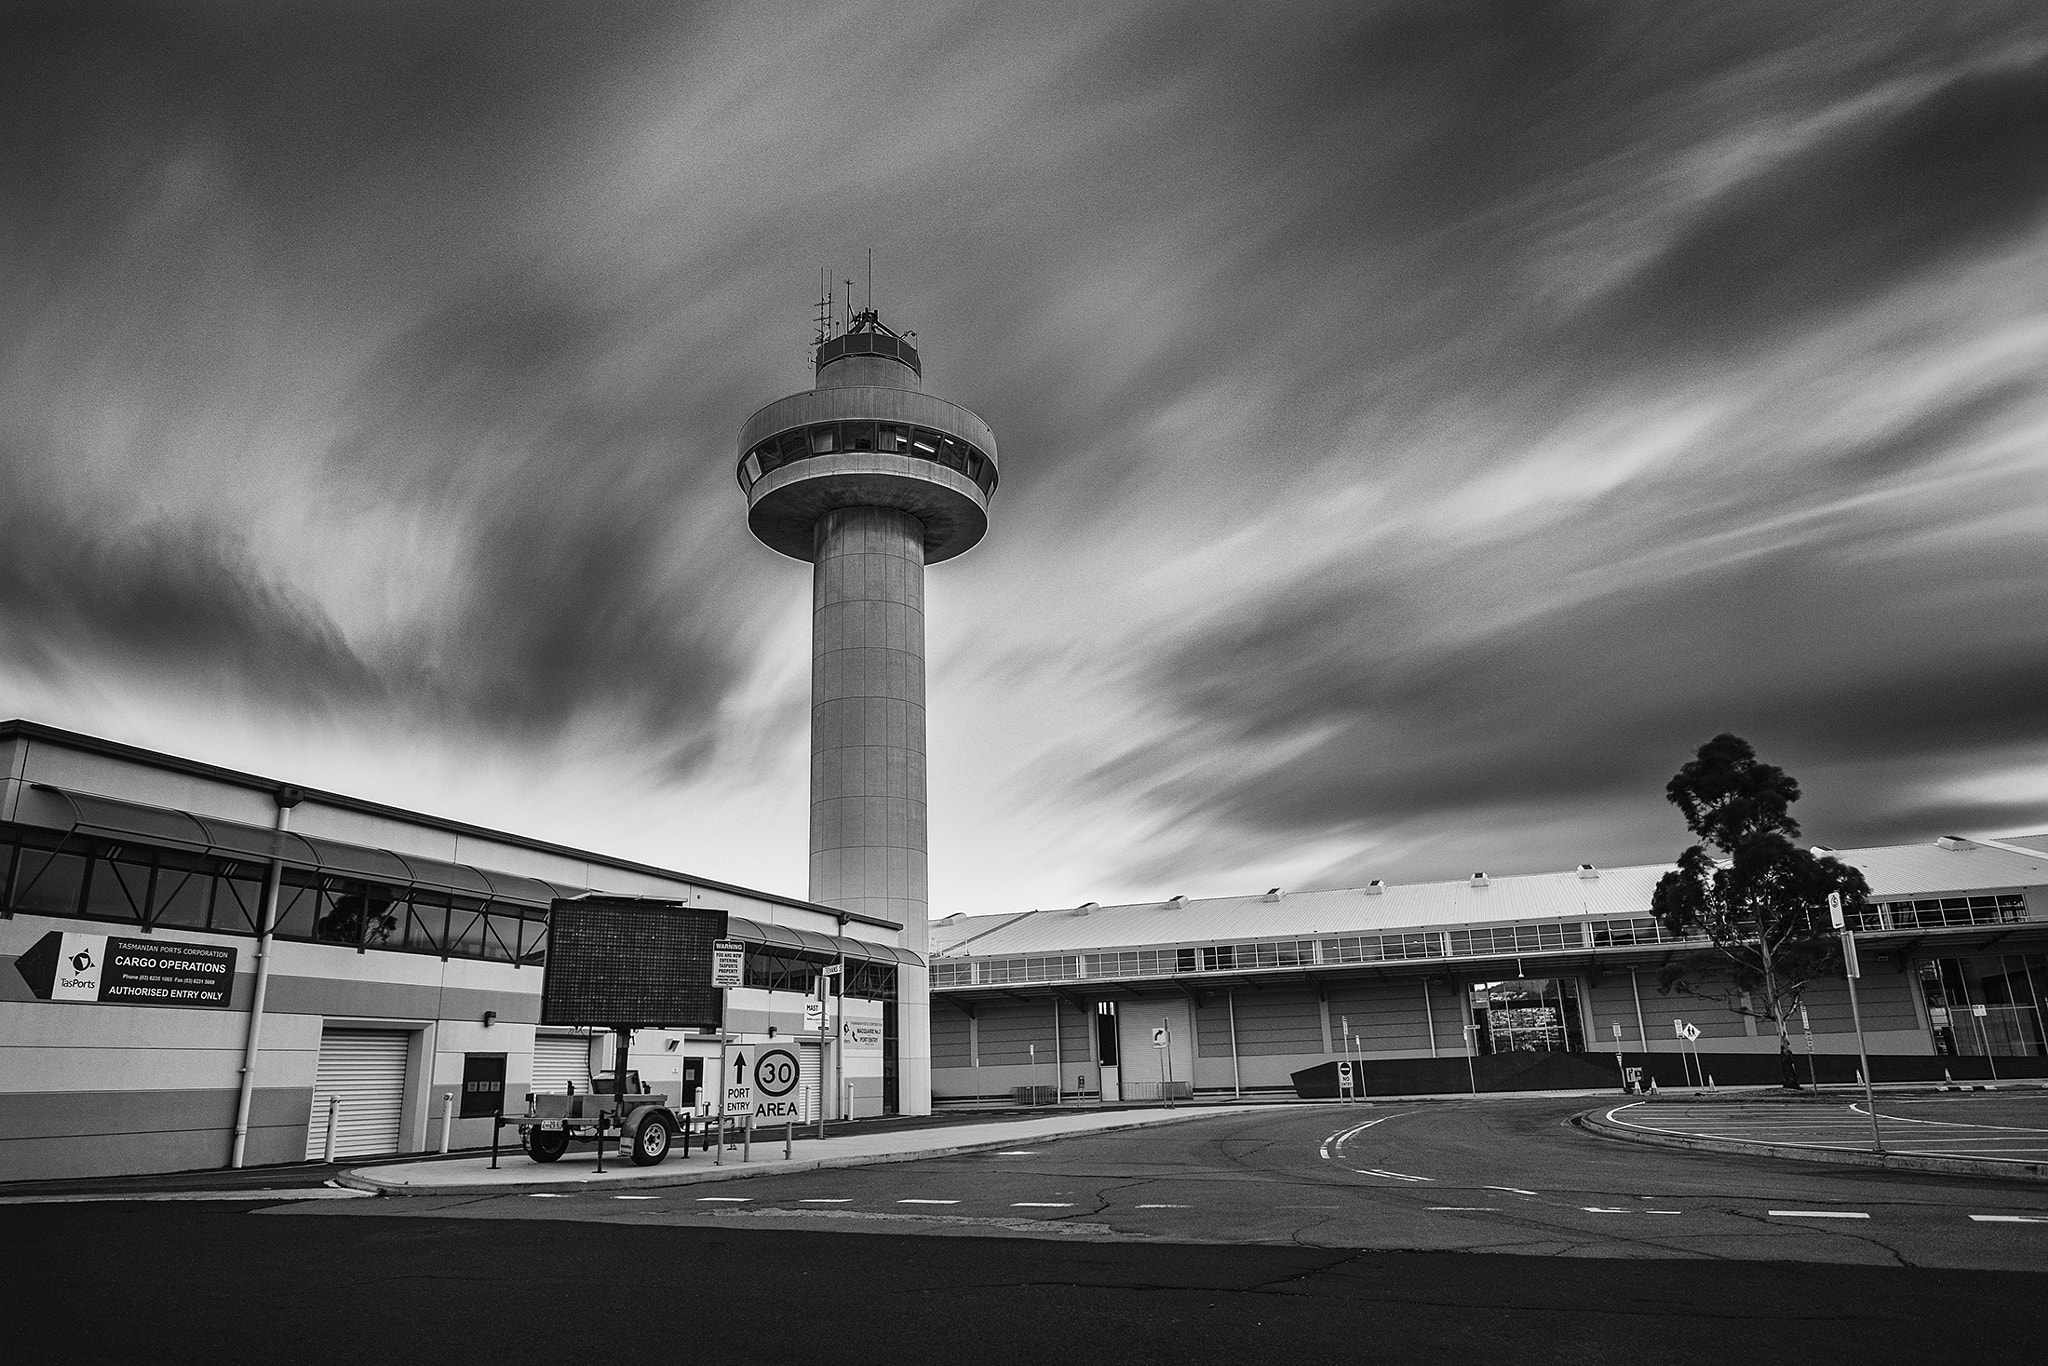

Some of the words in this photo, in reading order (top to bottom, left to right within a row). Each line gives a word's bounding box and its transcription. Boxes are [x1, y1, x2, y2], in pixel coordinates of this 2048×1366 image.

[118, 942, 159, 953] TASMANIAN
[160, 945, 182, 954] PORTS
[183, 948, 228, 958] CORPORATION
[115, 955, 157, 969] CARGO
[159, 959, 226, 973] OPERATIONS
[61, 977, 96, 988] TasPorts
[108, 986, 169, 998] AUTHORISED
[170, 989, 199, 999] ENTRY
[200, 991, 223, 1000] ONLY
[762, 1062, 792, 1084] 30
[728, 1087, 750, 1099] PORT
[727, 1101, 750, 1112] ENTRY
[755, 1101, 798, 1118] AREA
